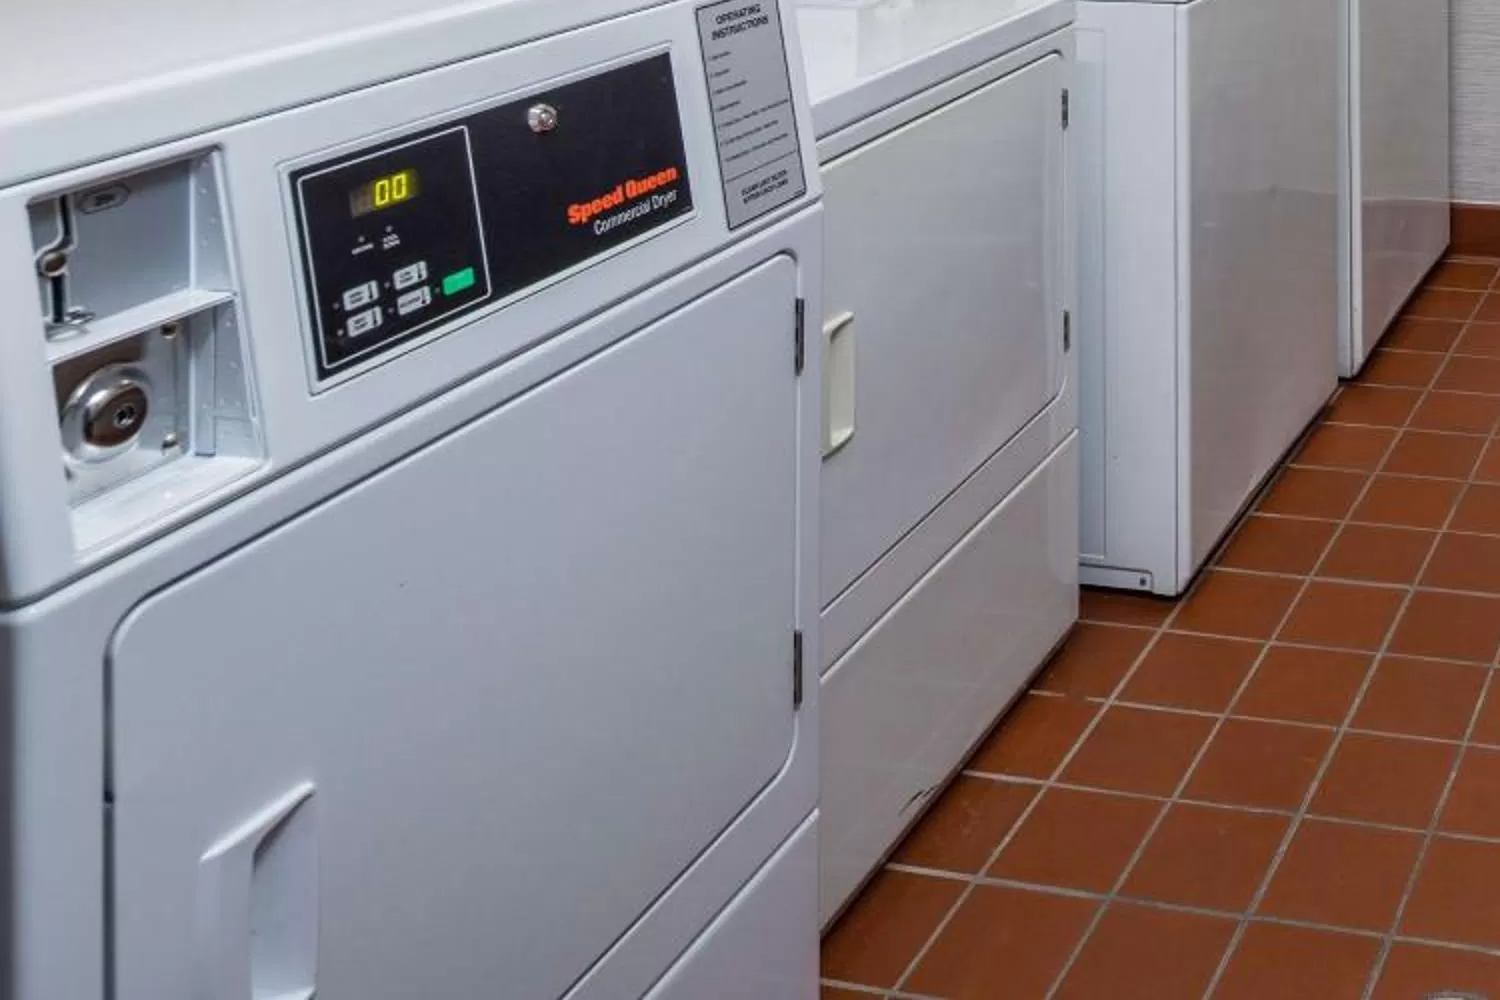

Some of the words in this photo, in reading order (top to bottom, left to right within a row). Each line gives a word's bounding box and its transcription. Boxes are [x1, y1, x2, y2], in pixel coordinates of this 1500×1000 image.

[375, 173, 407, 206] 00
[567, 183, 624, 224] Speed
[625, 167, 677, 198] Queen
[593, 199, 651, 236] Commercial
[651, 189, 678, 208] Dryer
